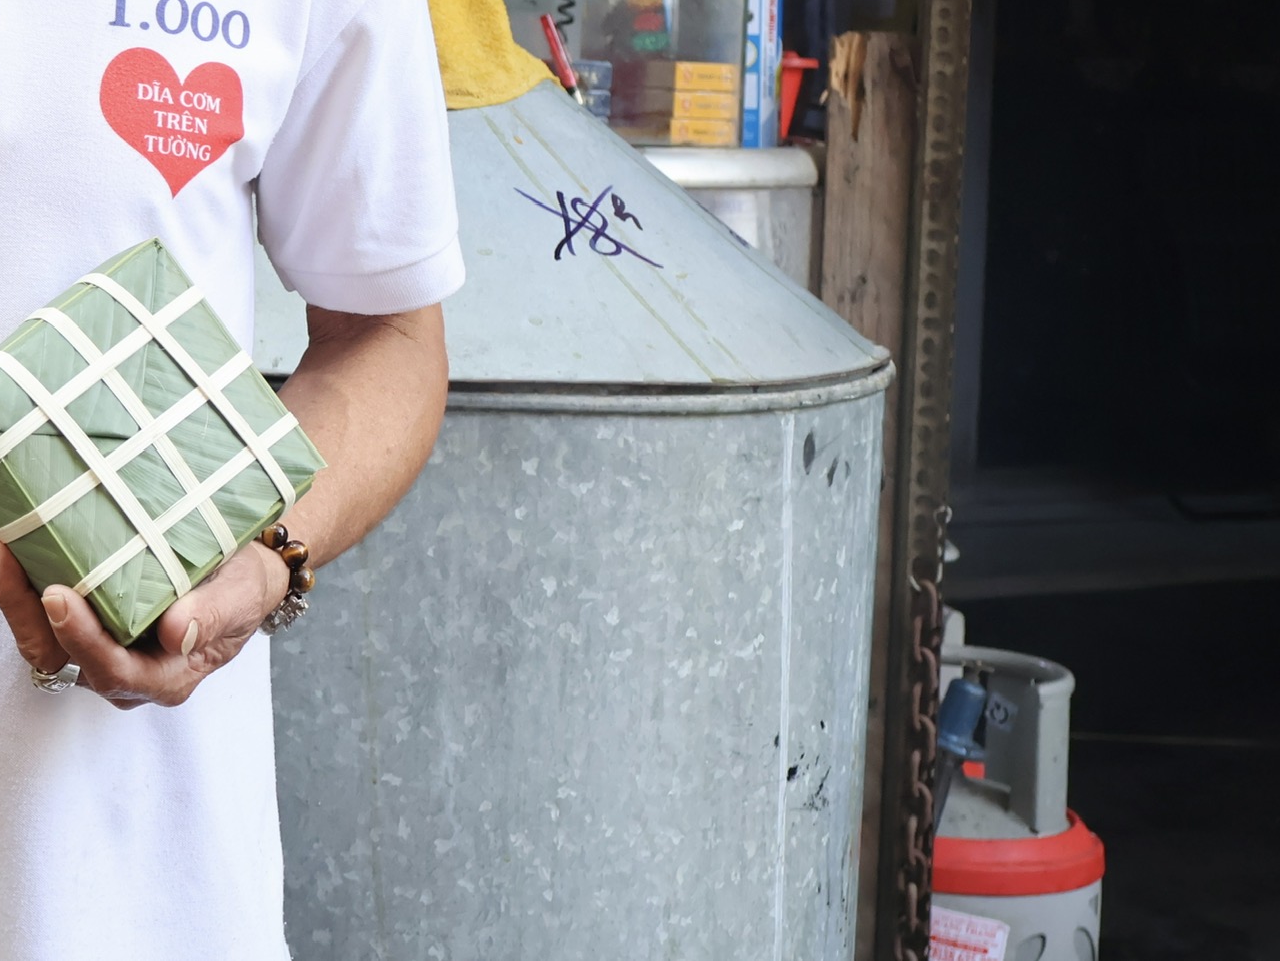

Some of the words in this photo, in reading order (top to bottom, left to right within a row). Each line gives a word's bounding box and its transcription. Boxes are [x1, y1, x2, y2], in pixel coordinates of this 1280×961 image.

[137, 80, 175, 105] DĨA
[179, 90, 222, 114] CƠM
[153, 109, 209, 135] TRÊN
[143, 134, 212, 162] TƯỜNG
